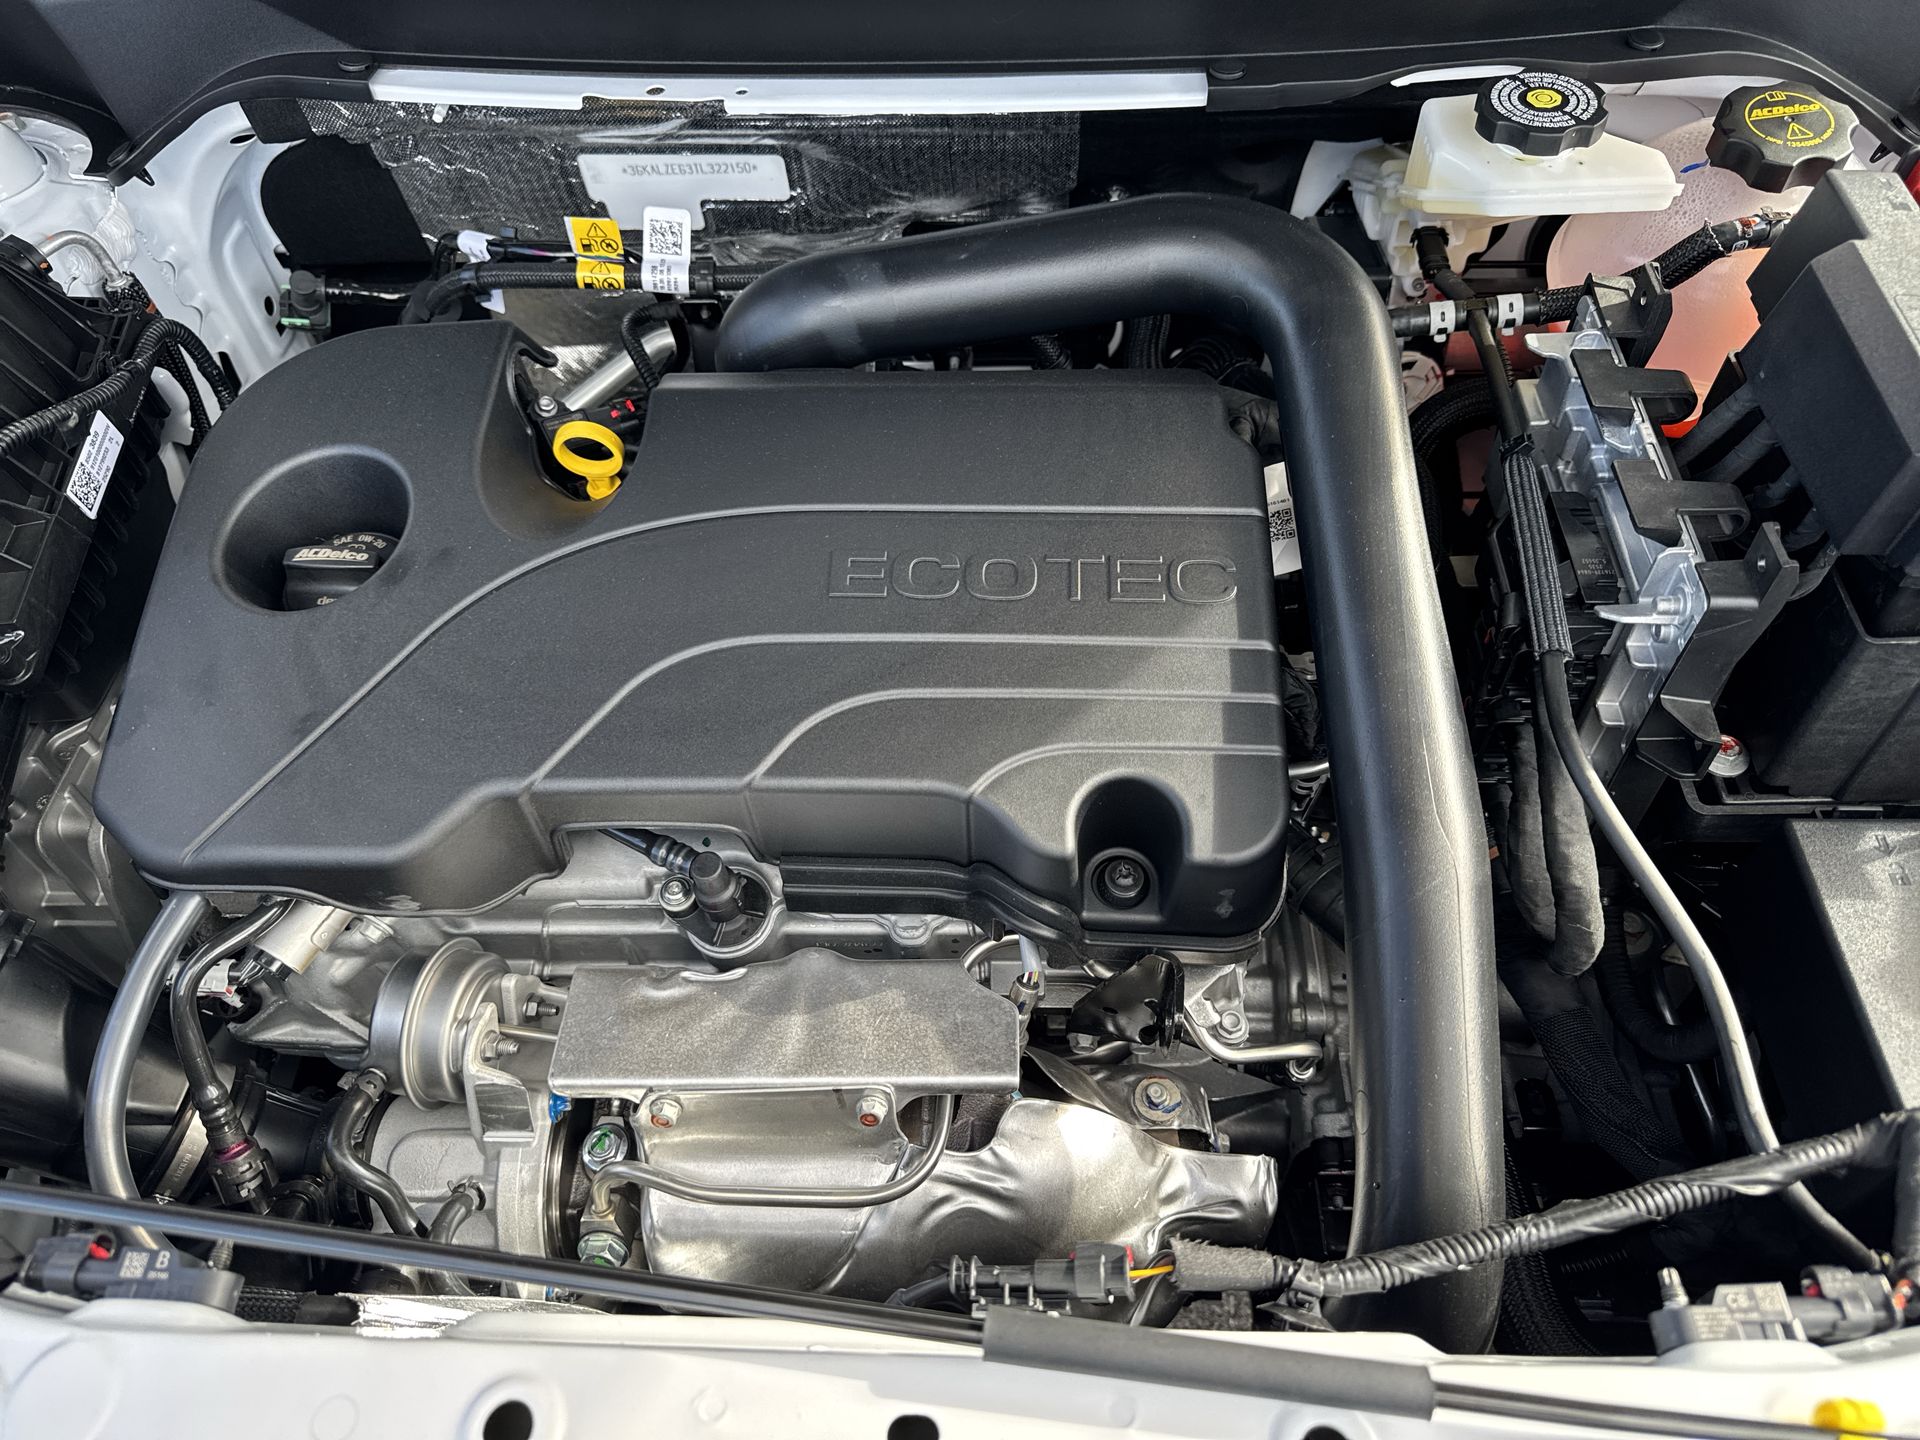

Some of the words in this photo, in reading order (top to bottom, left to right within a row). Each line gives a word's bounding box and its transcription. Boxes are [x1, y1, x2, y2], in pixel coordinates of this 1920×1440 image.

[1750, 102, 1822, 118] ACDelco
[89, 430, 100, 450] 3839
[333, 534, 354, 546] SAE
[358, 534, 388, 550] 0W-20
[294, 548, 370, 561] ACDelco
[828, 550, 1238, 604] ECOTEC
[155, 1250, 171, 1268] B
